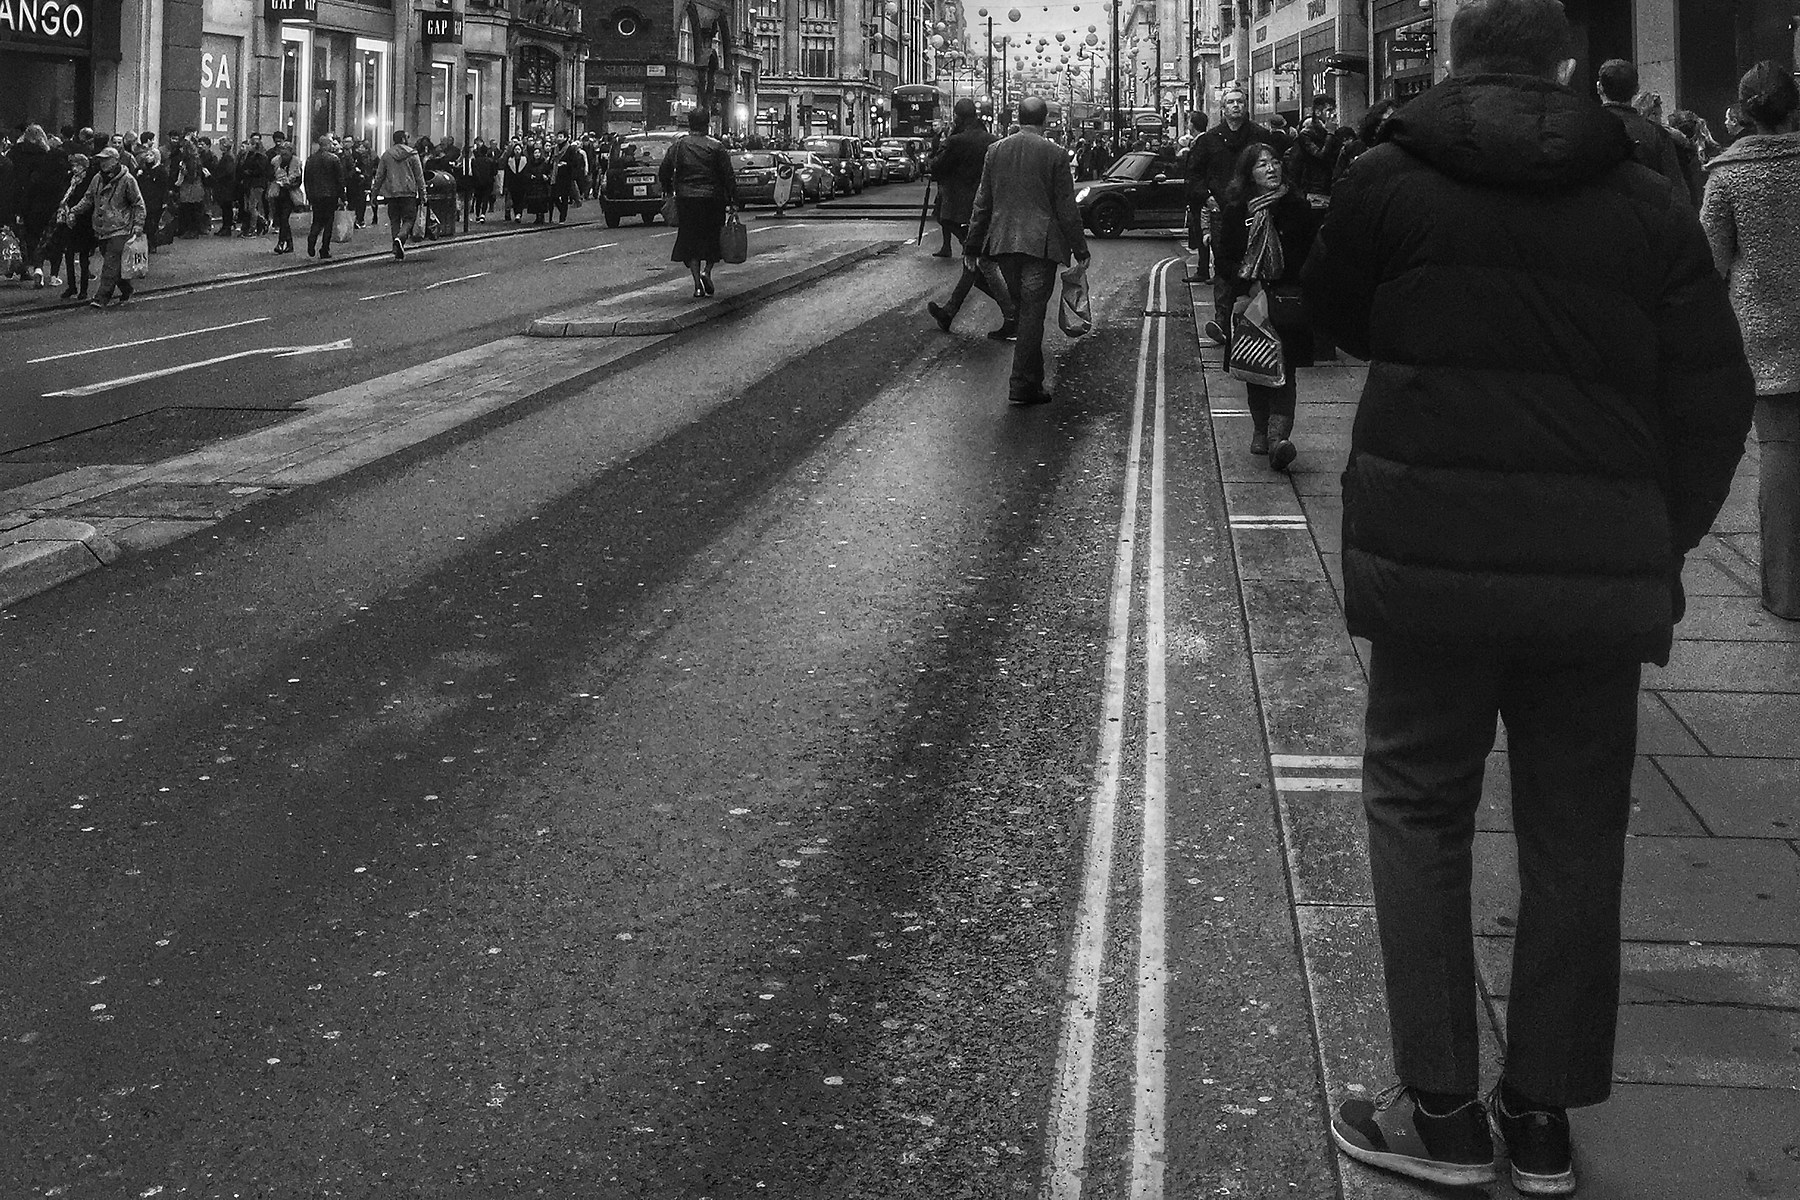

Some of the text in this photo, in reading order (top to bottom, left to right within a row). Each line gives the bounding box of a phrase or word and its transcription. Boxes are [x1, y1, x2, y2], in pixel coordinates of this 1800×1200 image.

[427, 19, 448, 35] GAP
[200, 52, 231, 89] SA
[200, 96, 230, 132] LE
